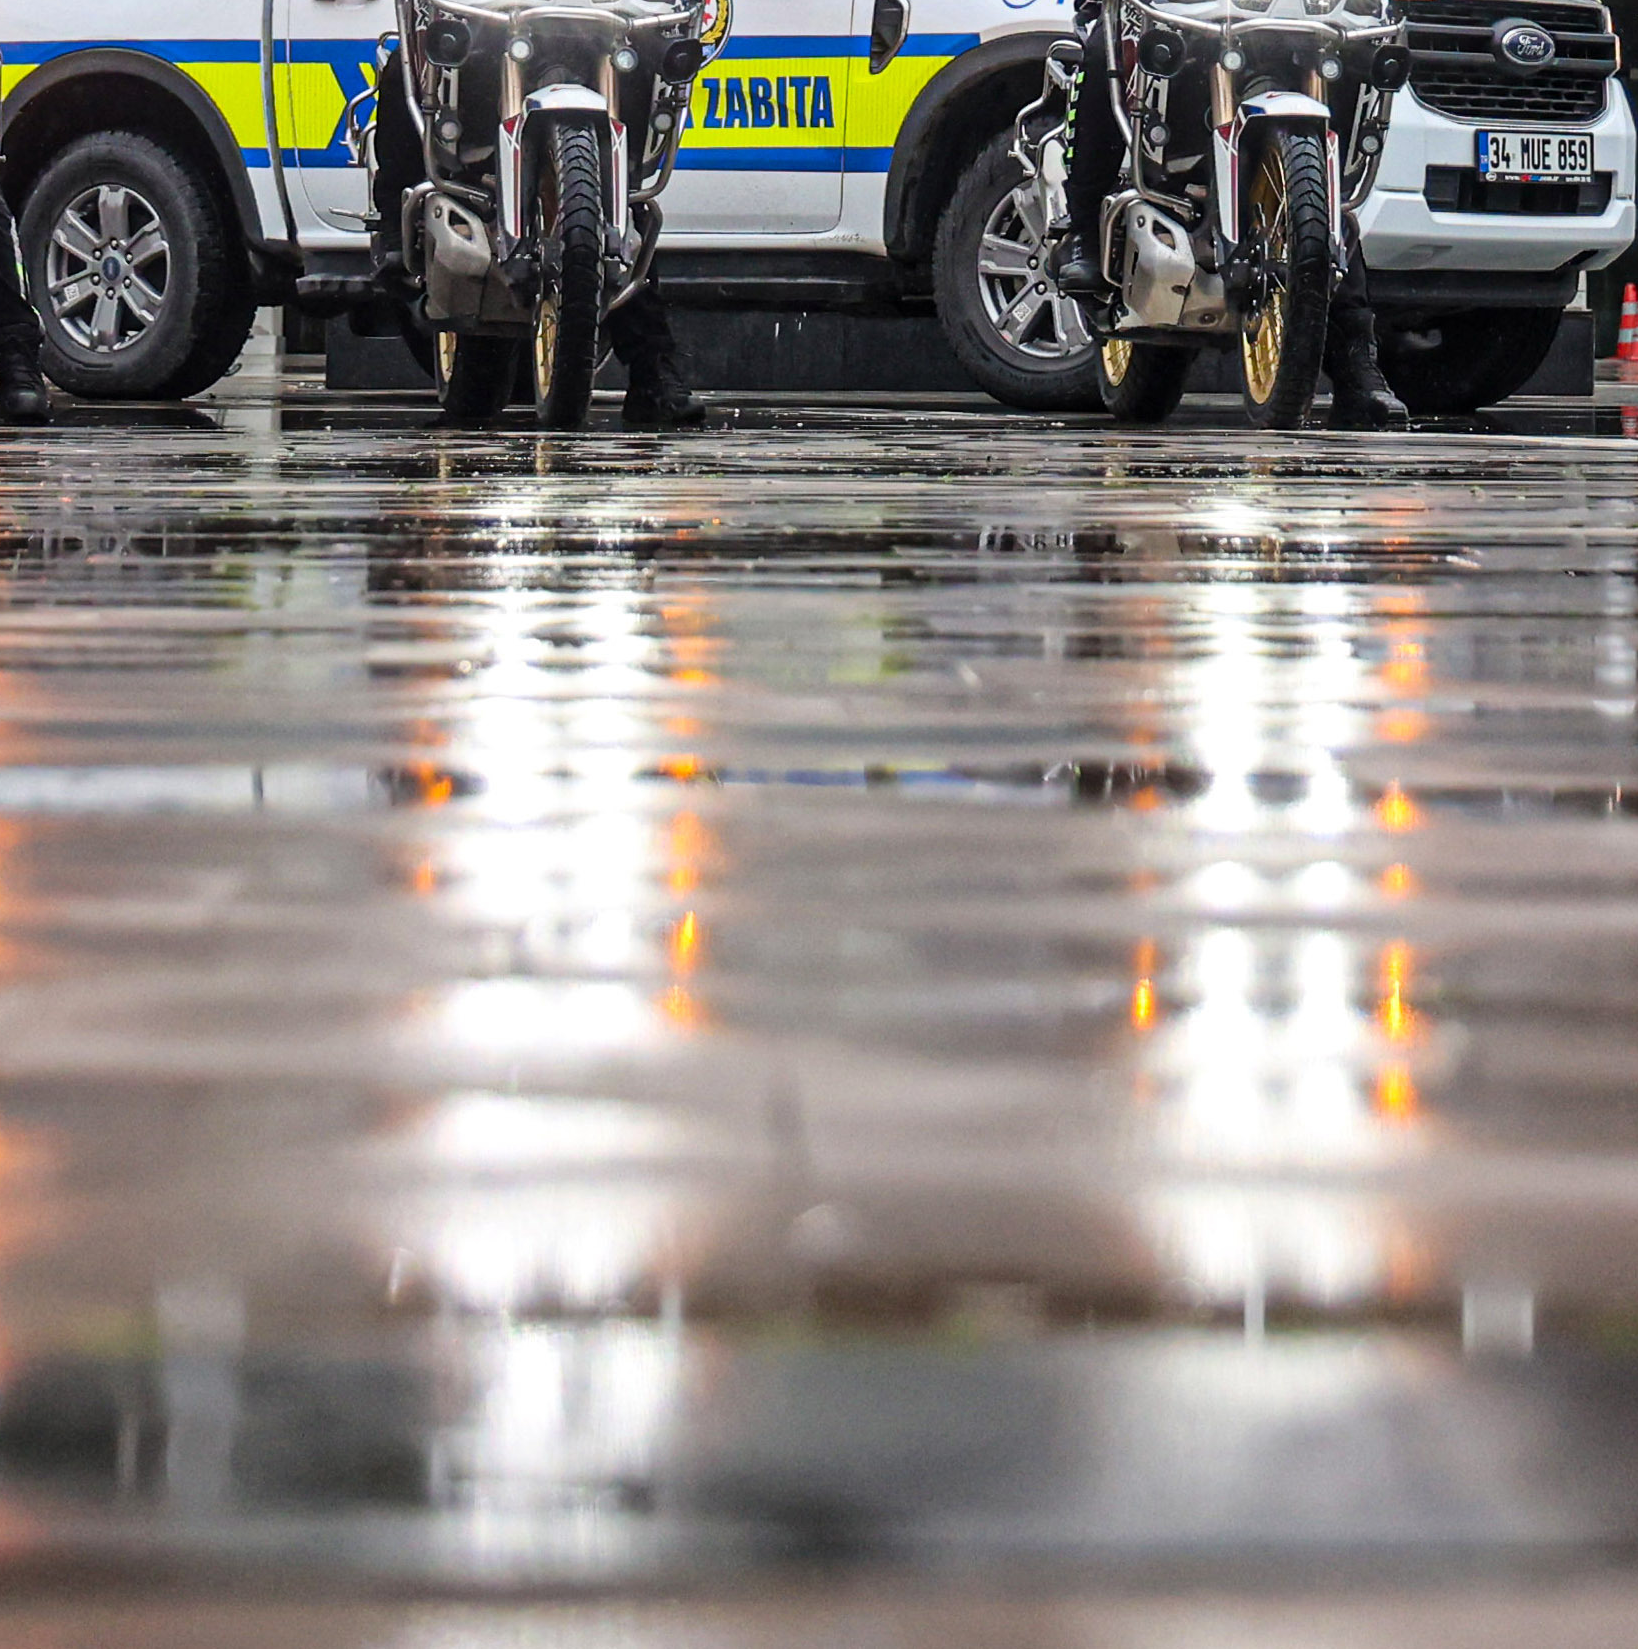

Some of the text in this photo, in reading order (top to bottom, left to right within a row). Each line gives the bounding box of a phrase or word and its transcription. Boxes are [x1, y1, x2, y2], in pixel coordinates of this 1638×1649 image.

[1517, 34, 1546, 56] Ford
[702, 76, 835, 128] ZABITA
[1490, 136, 1587, 171] 34 MUE 859
